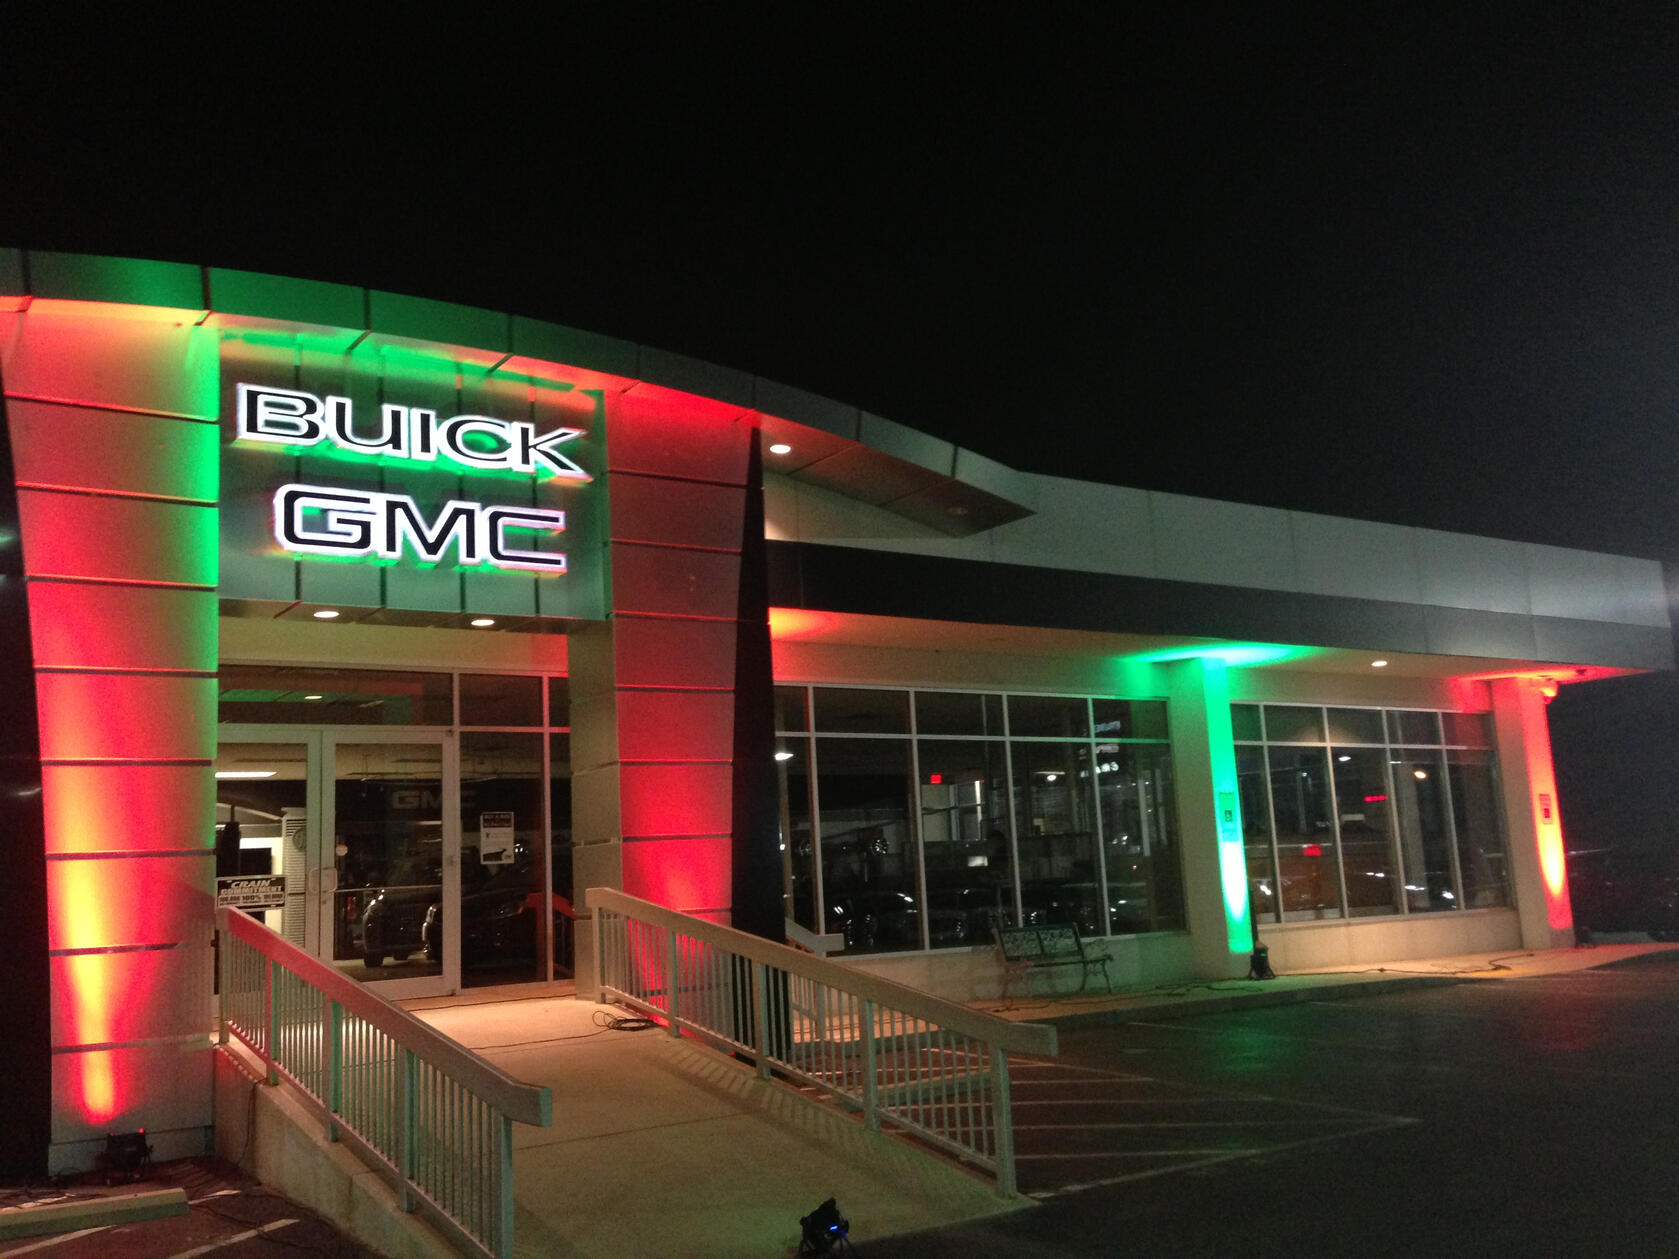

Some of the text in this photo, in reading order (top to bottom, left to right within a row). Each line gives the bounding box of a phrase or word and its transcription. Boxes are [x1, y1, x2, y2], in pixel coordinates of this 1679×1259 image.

[238, 384, 591, 481] BUICK
[274, 485, 566, 571] GMC
[220, 886, 282, 896] COMMITMENT
